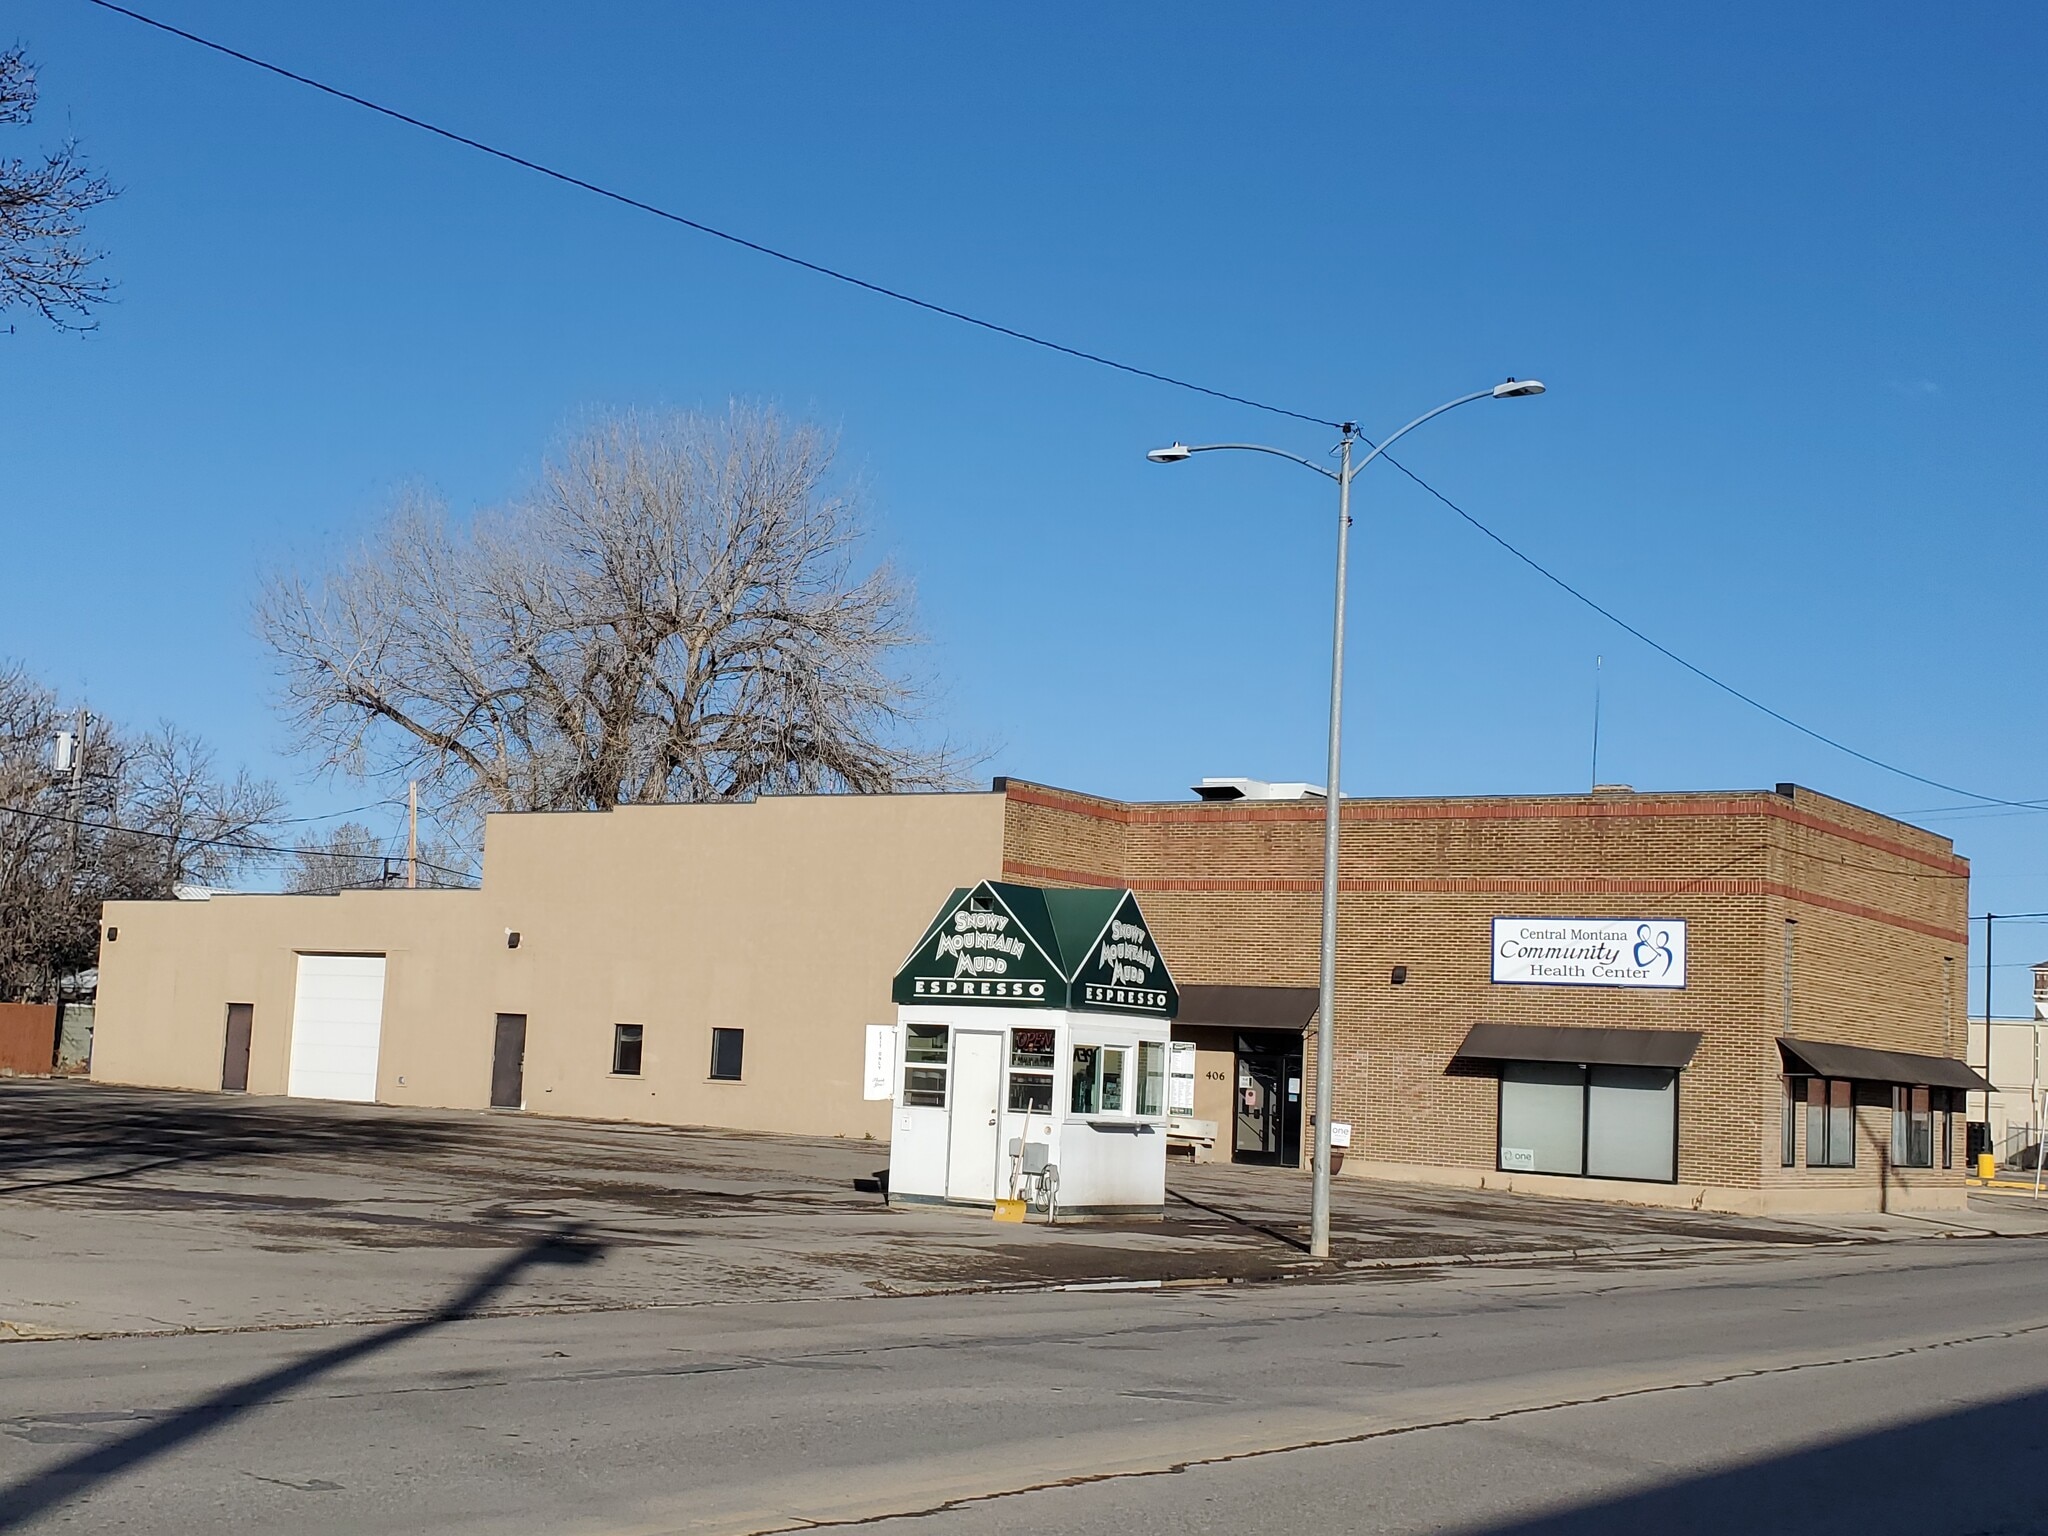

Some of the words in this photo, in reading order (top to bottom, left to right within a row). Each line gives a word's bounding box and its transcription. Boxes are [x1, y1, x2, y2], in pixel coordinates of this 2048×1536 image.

[954, 910, 1009, 932] SNOWY
[1111, 919, 1146, 944] SNOWY
[1520, 928, 1566, 940] Central
[1571, 929, 1628, 941] Montana
[935, 930, 1026, 961] MOUNTAIN
[1500, 940, 1621, 966] Community
[953, 950, 1008, 980] MUDD
[1098, 940, 1156, 973] MOUNTAIN
[1111, 959, 1145, 988] MUDD
[1530, 964, 1585, 977] Health
[1592, 965, 1651, 979] Center
[915, 980, 1045, 997] ESPRESSO
[1086, 987, 1167, 1007] ESPRESSO
[1205, 1070, 1226, 1081] 406
[1332, 1127, 1350, 1136] one
[1514, 1153, 1532, 1161] one
